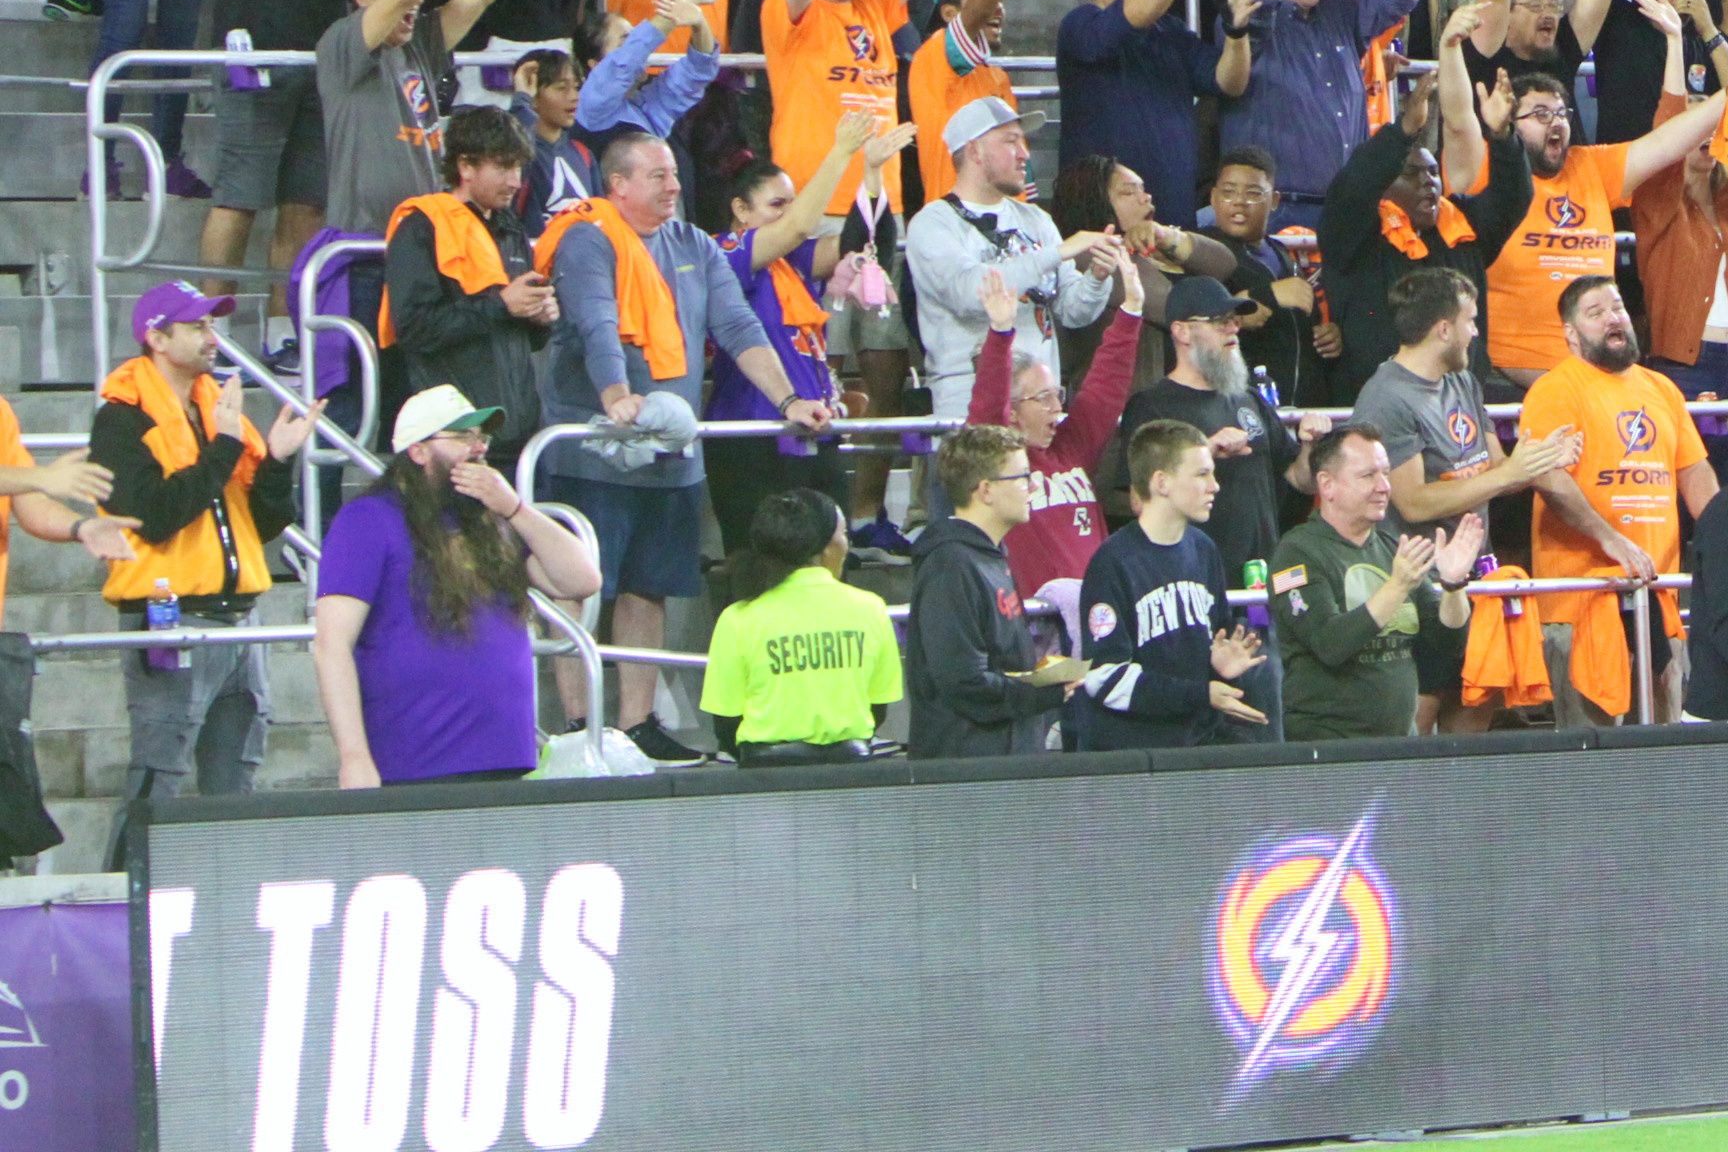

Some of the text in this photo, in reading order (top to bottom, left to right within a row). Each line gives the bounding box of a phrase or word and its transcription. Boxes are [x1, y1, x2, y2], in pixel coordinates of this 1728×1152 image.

[1521, 233, 1613, 251] STORM
[1619, 461, 1663, 470] ORLANDO
[1596, 469, 1671, 487] STORM
[766, 630, 866, 676] SECURITY
[252, 861, 625, 1152] TOSS
